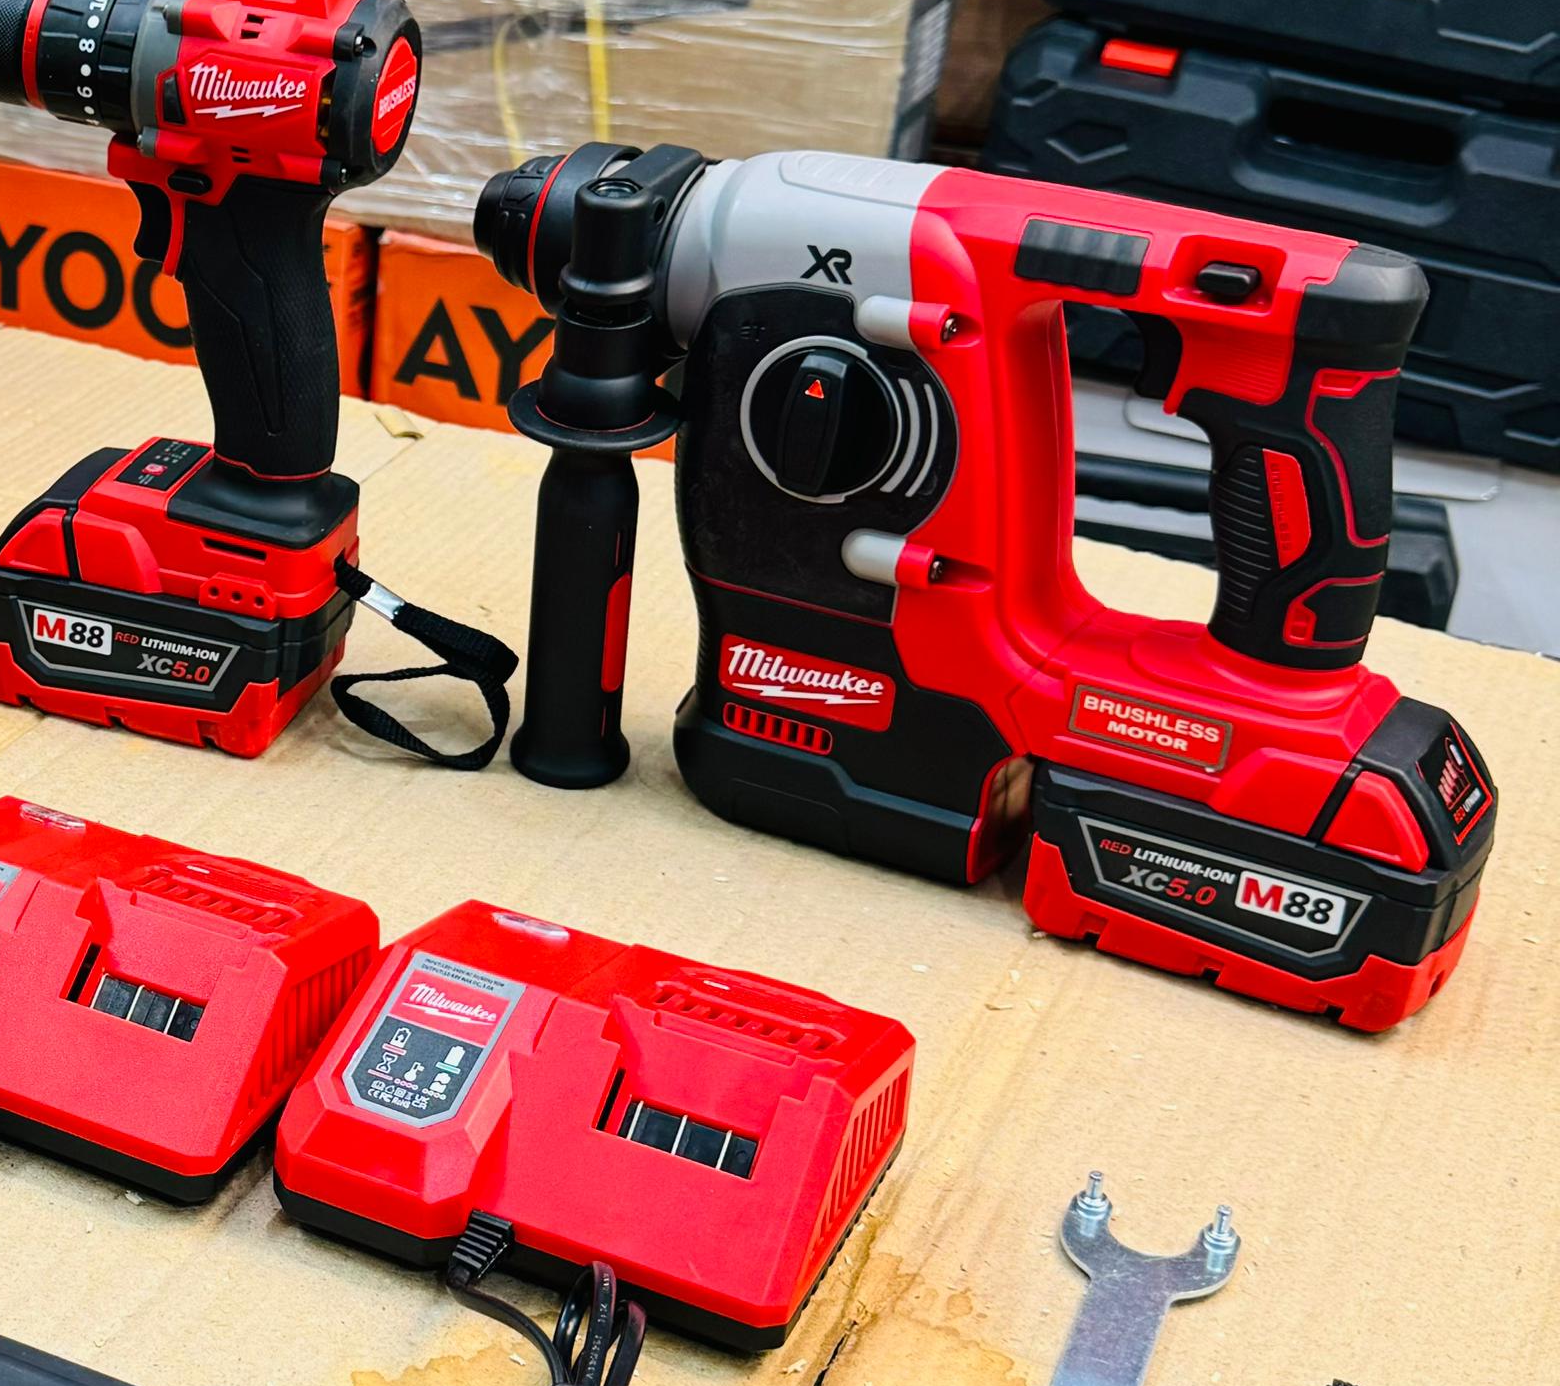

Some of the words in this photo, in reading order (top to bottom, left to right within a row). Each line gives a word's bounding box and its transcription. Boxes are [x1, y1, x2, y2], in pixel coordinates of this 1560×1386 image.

[78, 38, 96, 53] 8
[77, 85, 93, 98] 6
[188, 62, 307, 101] Milwaukee
[377, 76, 417, 120] BRUSHLESS
[800, 244, 852, 285] XR
[394, 298, 557, 405] AY
[37, 613, 106, 650] M88
[114, 630, 139, 646] RED
[141, 637, 220, 663] LITHIUM-ION
[136, 653, 211, 684] XC5.0
[728, 644, 884, 696] Milwaukee
[1083, 695, 1221, 743] BRUSHLESS
[1107, 720, 1189, 752] MOTOR
[1099, 837, 1132, 855] RED
[1133, 847, 1237, 885] LITHIUM-ION
[1240, 877, 1335, 926] M88
[1120, 864, 1217, 907] XC5.0
[410, 983, 497, 1022] Milwaukee
